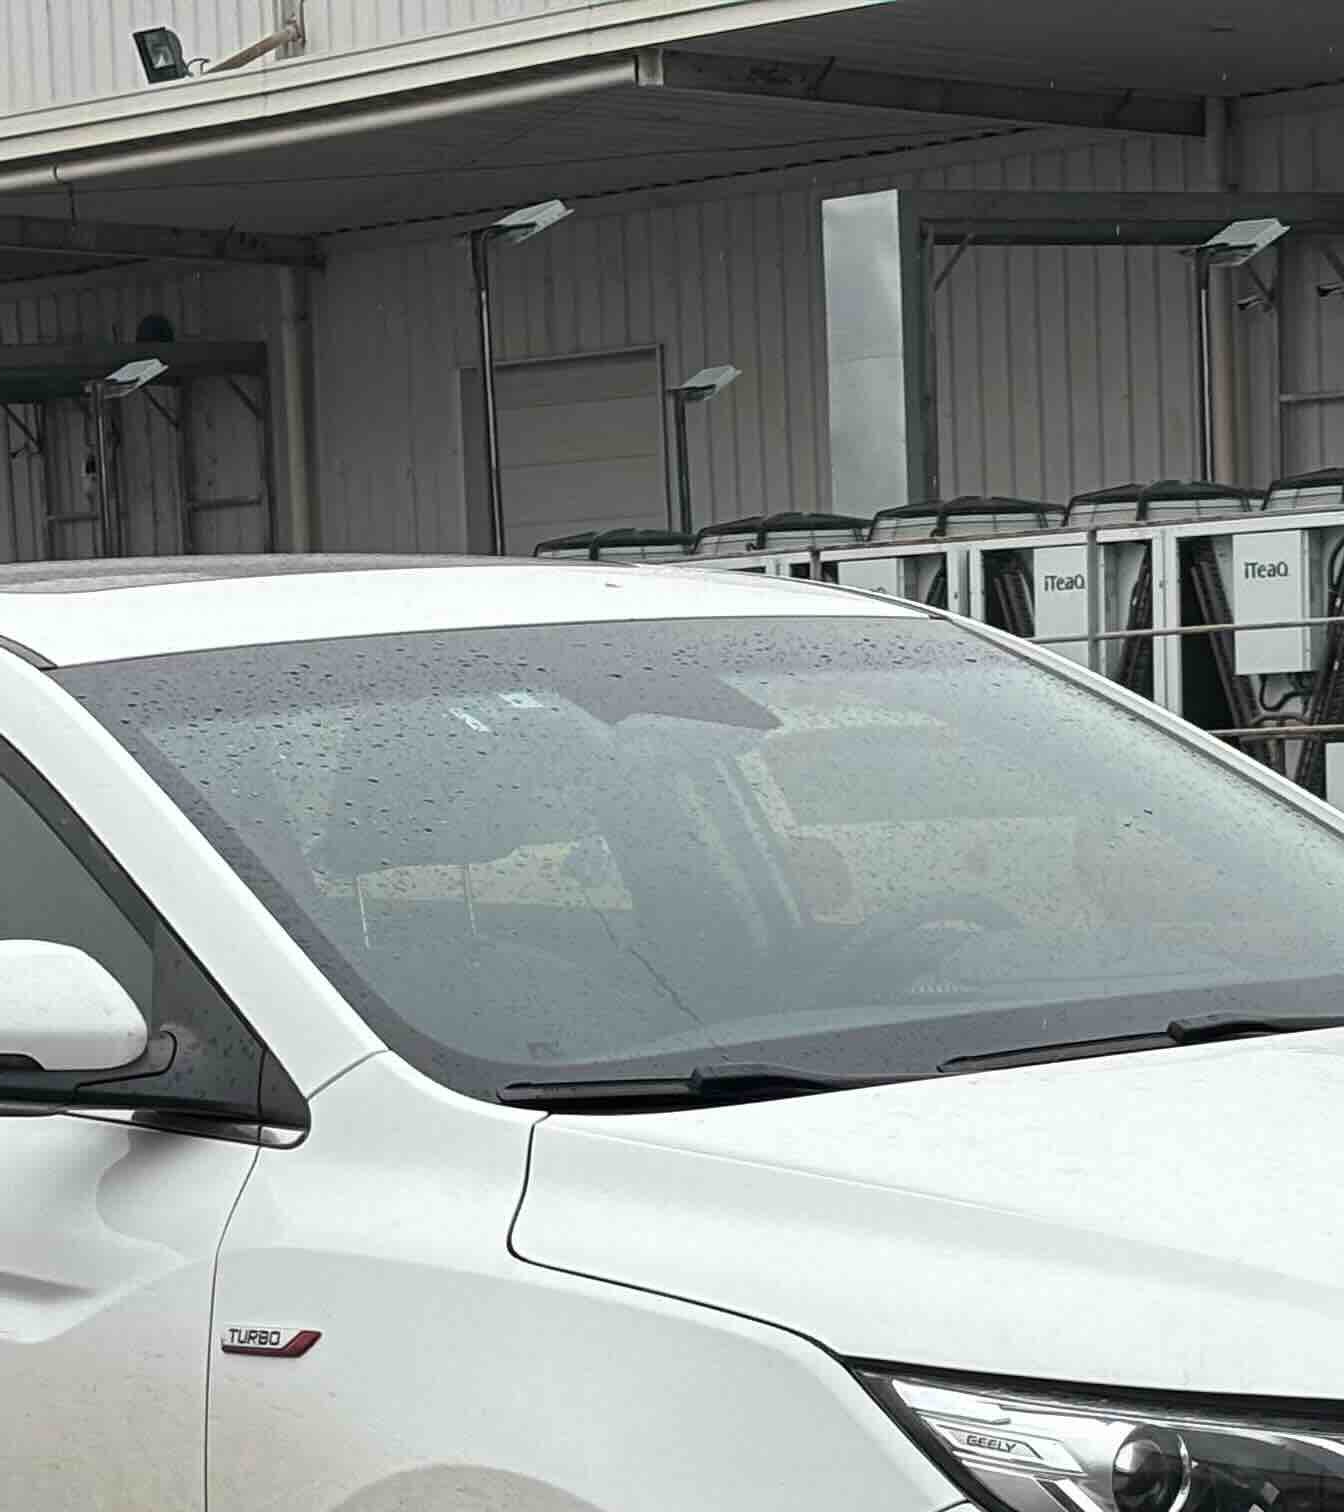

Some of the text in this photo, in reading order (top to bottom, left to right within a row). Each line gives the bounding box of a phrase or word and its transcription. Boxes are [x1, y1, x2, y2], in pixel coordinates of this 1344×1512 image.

[1243, 560, 1289, 580] iTeaQ
[1044, 573, 1085, 592] iTeaQ
[229, 1328, 281, 1346] TURBO
[966, 1435, 1017, 1453] GEELY
